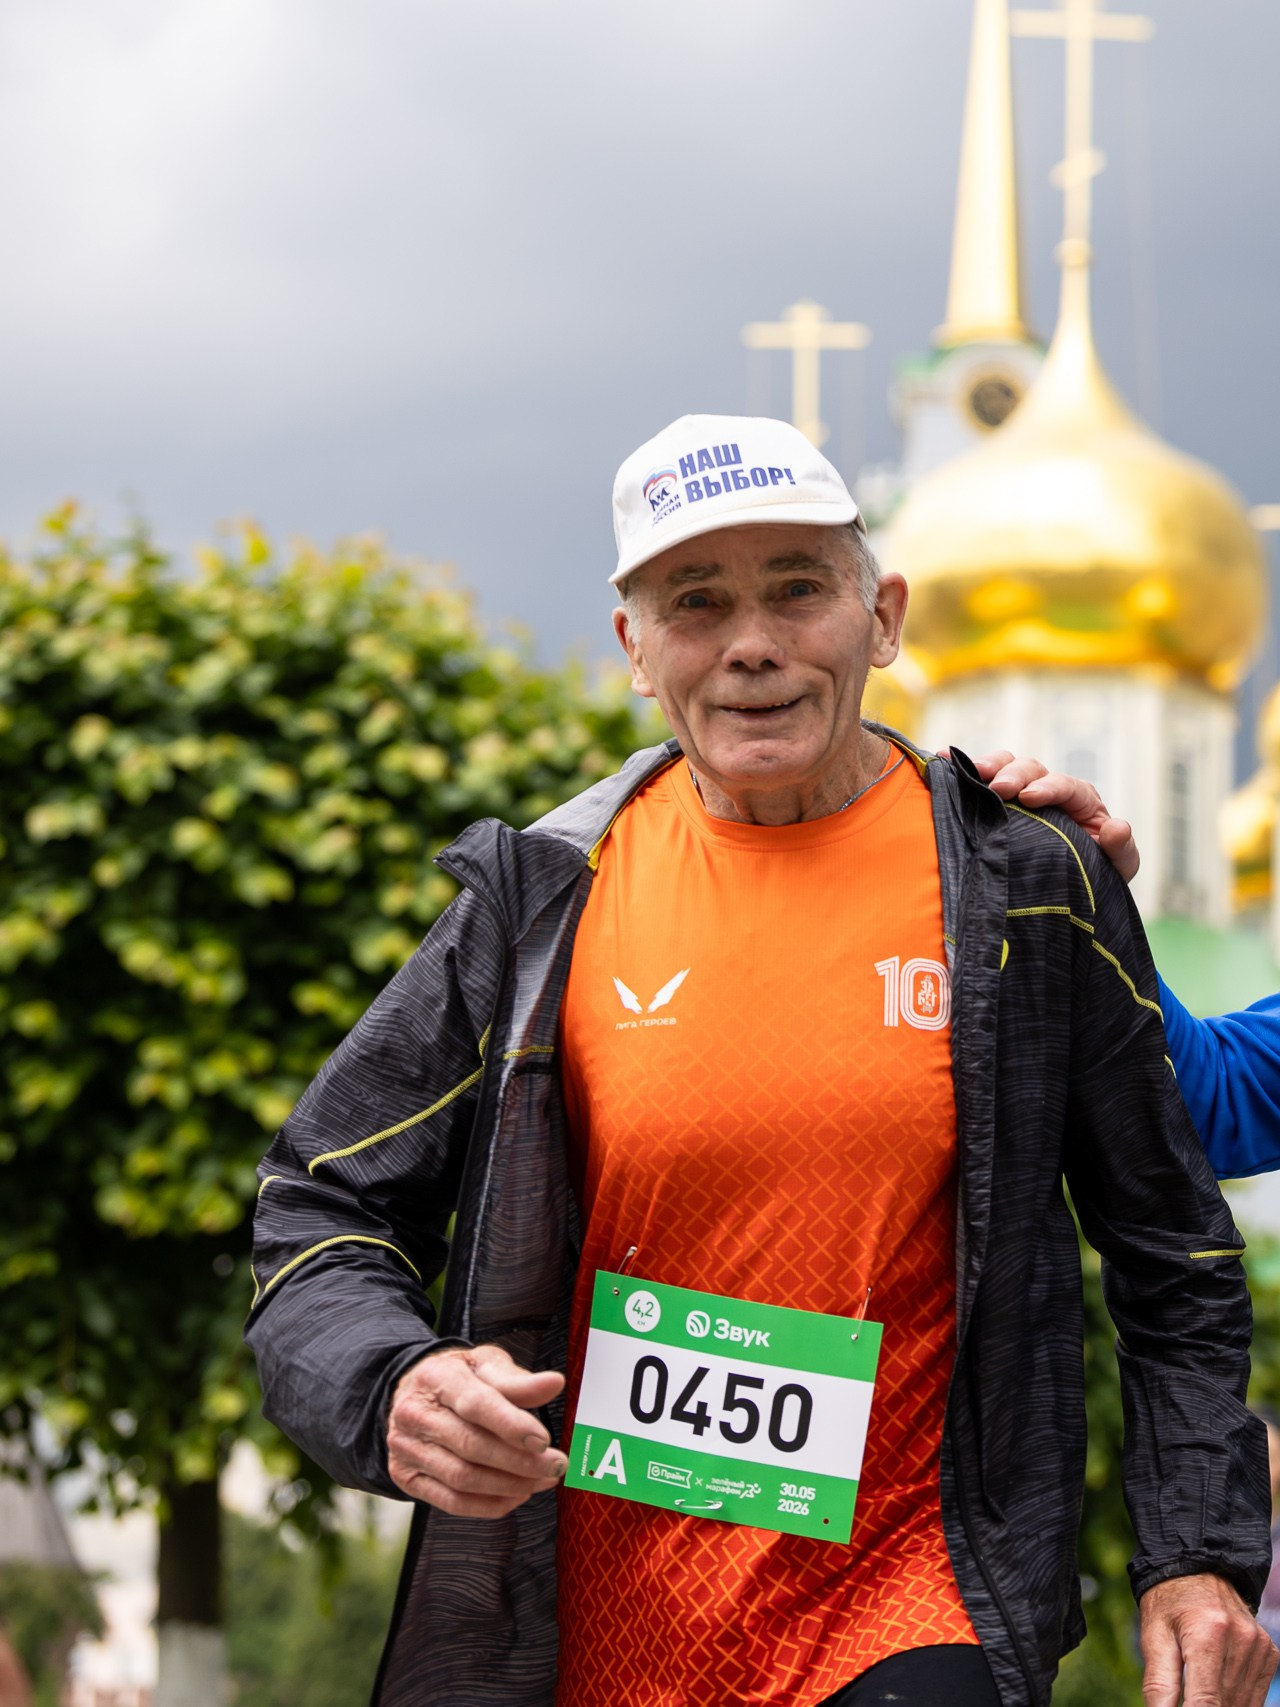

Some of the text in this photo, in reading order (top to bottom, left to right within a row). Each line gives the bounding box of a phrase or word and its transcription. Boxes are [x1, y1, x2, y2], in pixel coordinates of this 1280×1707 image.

[678, 443, 743, 479] НАШ
[684, 467, 796, 503] ВЫБОР!
[874, 955, 952, 1032] 10
[632, 1299, 655, 1318] 4,2
[713, 1318, 772, 1348] Звук
[629, 1355, 813, 1453] 0450
[660, 1470, 685, 1482] Прайм
[777, 1498, 809, 1515] 2026
[780, 1483, 816, 1500] 30.05
